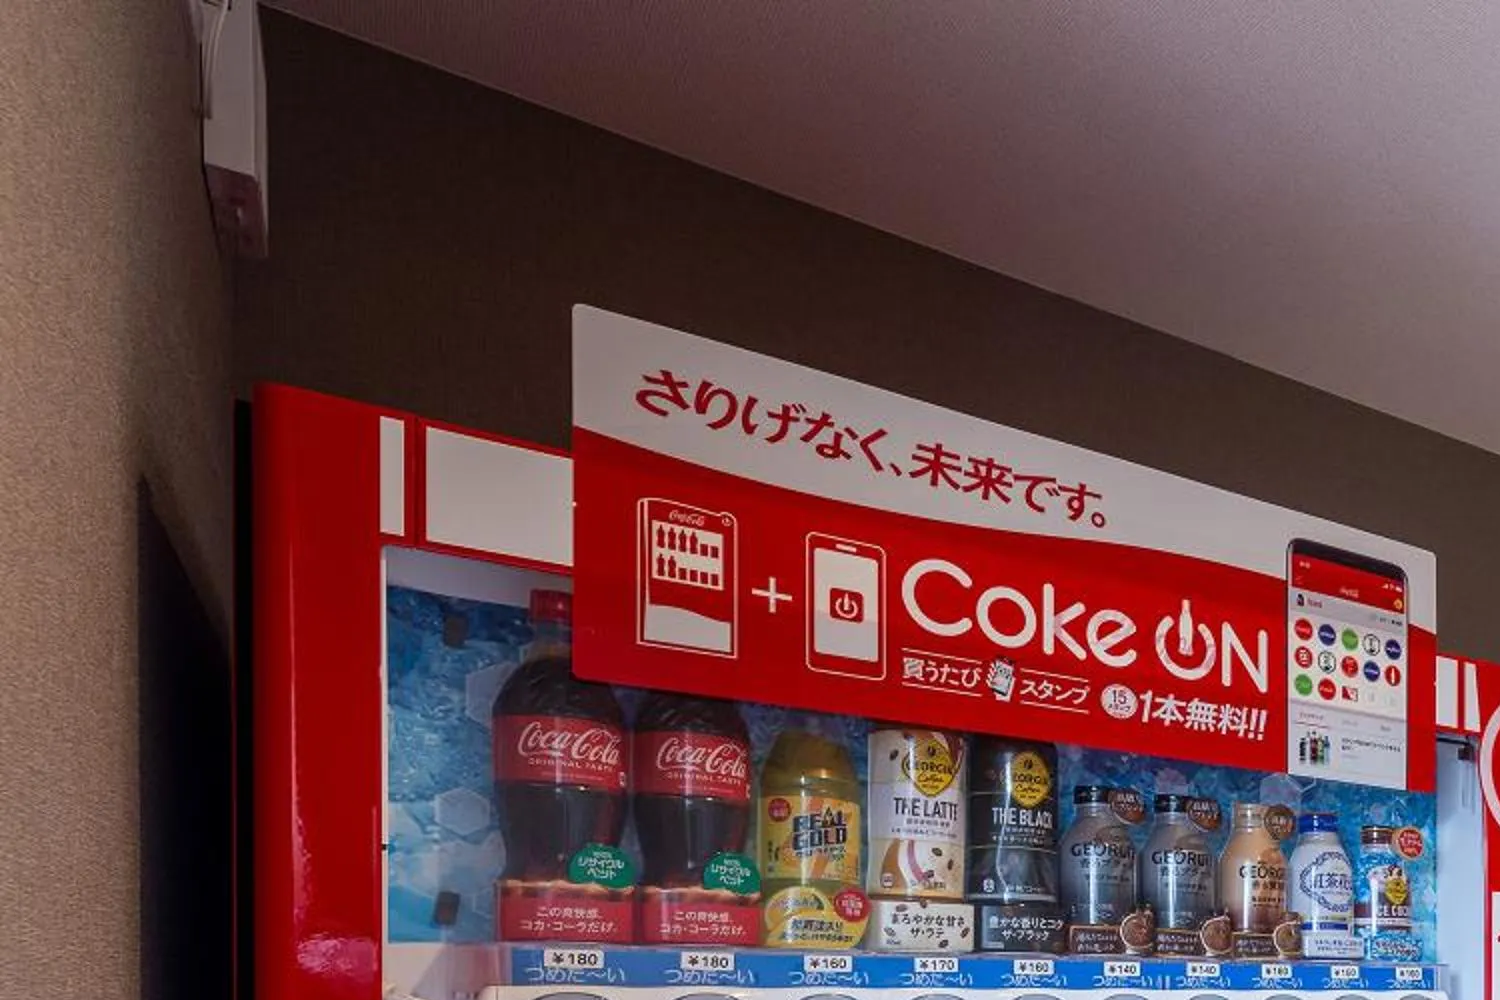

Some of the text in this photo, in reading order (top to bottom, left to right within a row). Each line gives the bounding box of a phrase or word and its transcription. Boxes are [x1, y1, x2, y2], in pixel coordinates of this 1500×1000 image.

[635, 369, 1107, 529] さりげなく、未来です。
[901, 557, 1137, 668] Coke
[1154, 598, 1269, 694] ON
[903, 657, 983, 688] 買うたび
[1019, 678, 1091, 705] スタンプ
[517, 721, 621, 765] Coca-Cola
[656, 737, 746, 778] Coca-Cola
[1071, 843, 1135, 859] GEORG
[1151, 851, 1212, 865] GEORG
[1239, 862, 1283, 879] GEORG
[552, 952, 598, 966] ¥180
[687, 954, 729, 967] ¥180
[919, 959, 954, 971] ¥170
